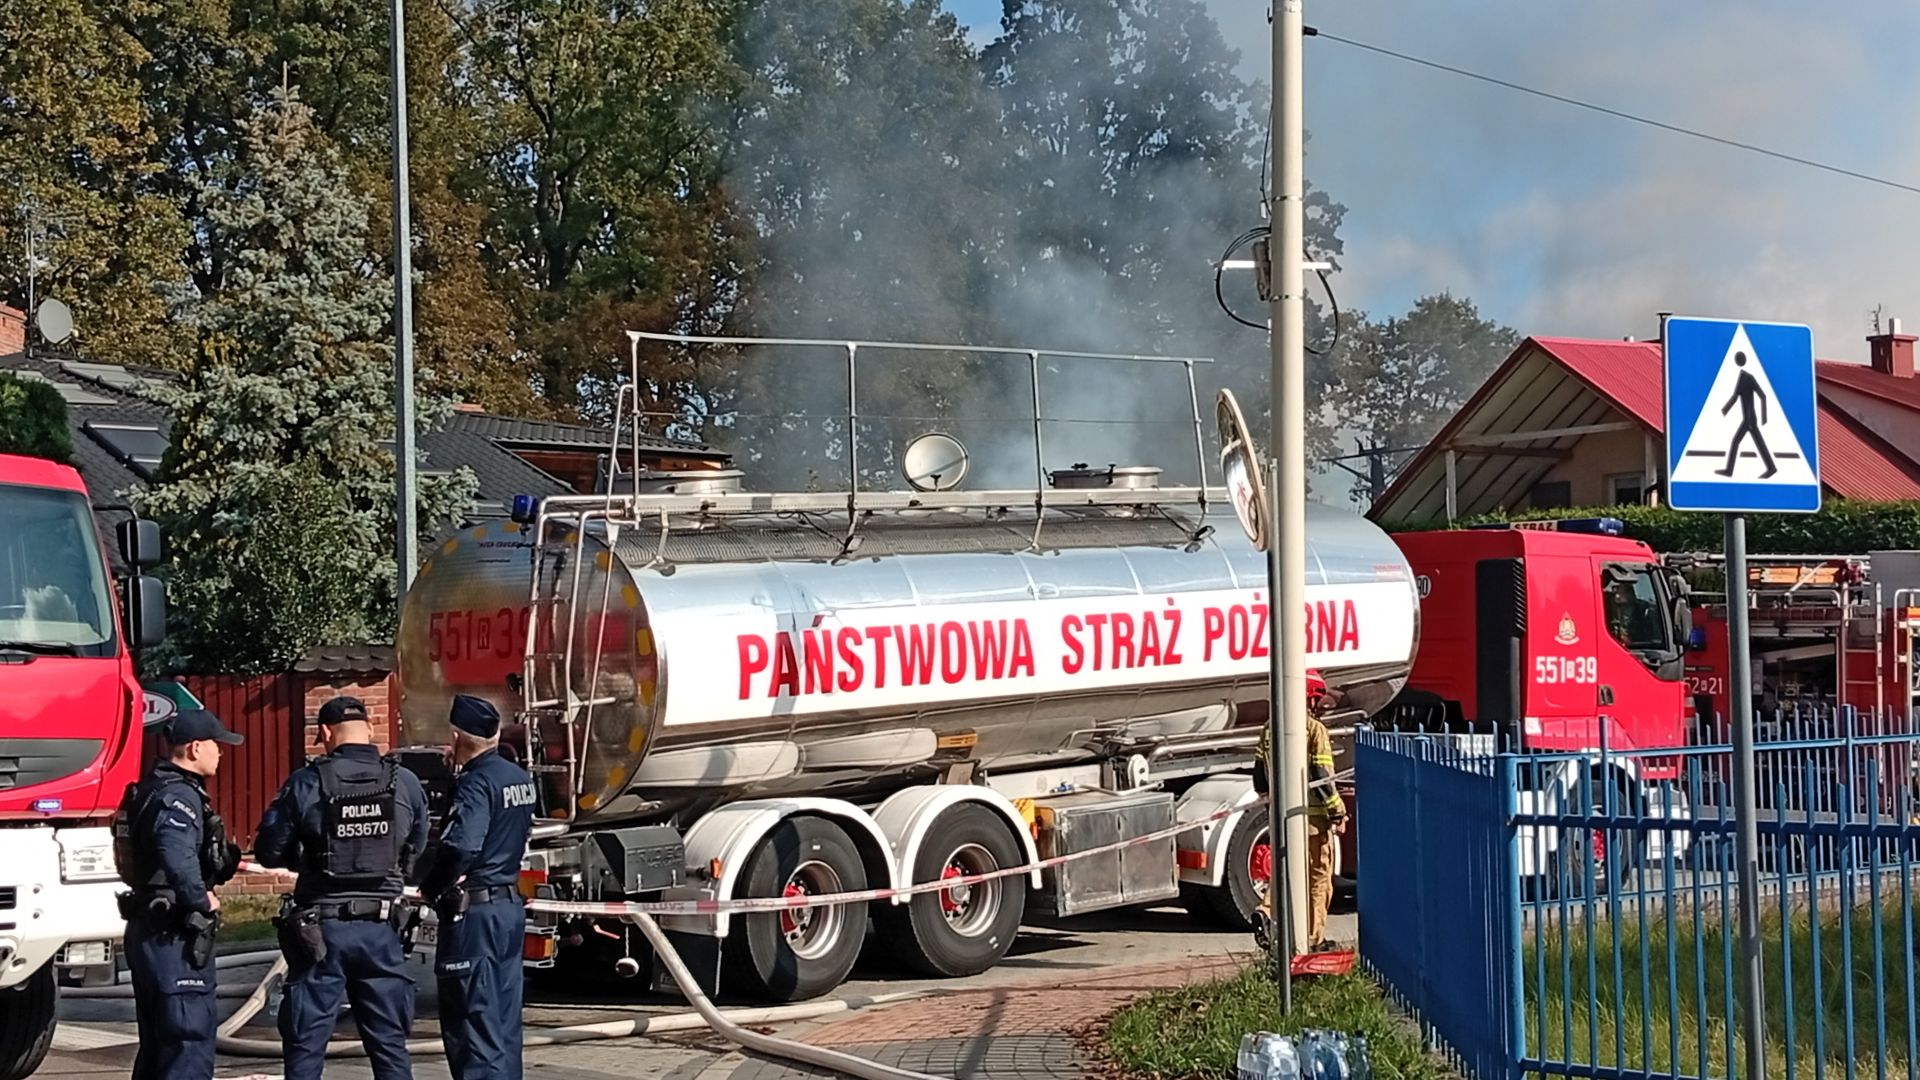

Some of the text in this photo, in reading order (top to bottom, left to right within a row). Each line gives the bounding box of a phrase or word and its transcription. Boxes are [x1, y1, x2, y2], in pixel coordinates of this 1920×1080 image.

[737, 592, 1359, 700] PAŃSTWOWA STRAŻ POŻRNA
[342, 804, 382, 818] POLICJA
[337, 821, 389, 837] 853670
